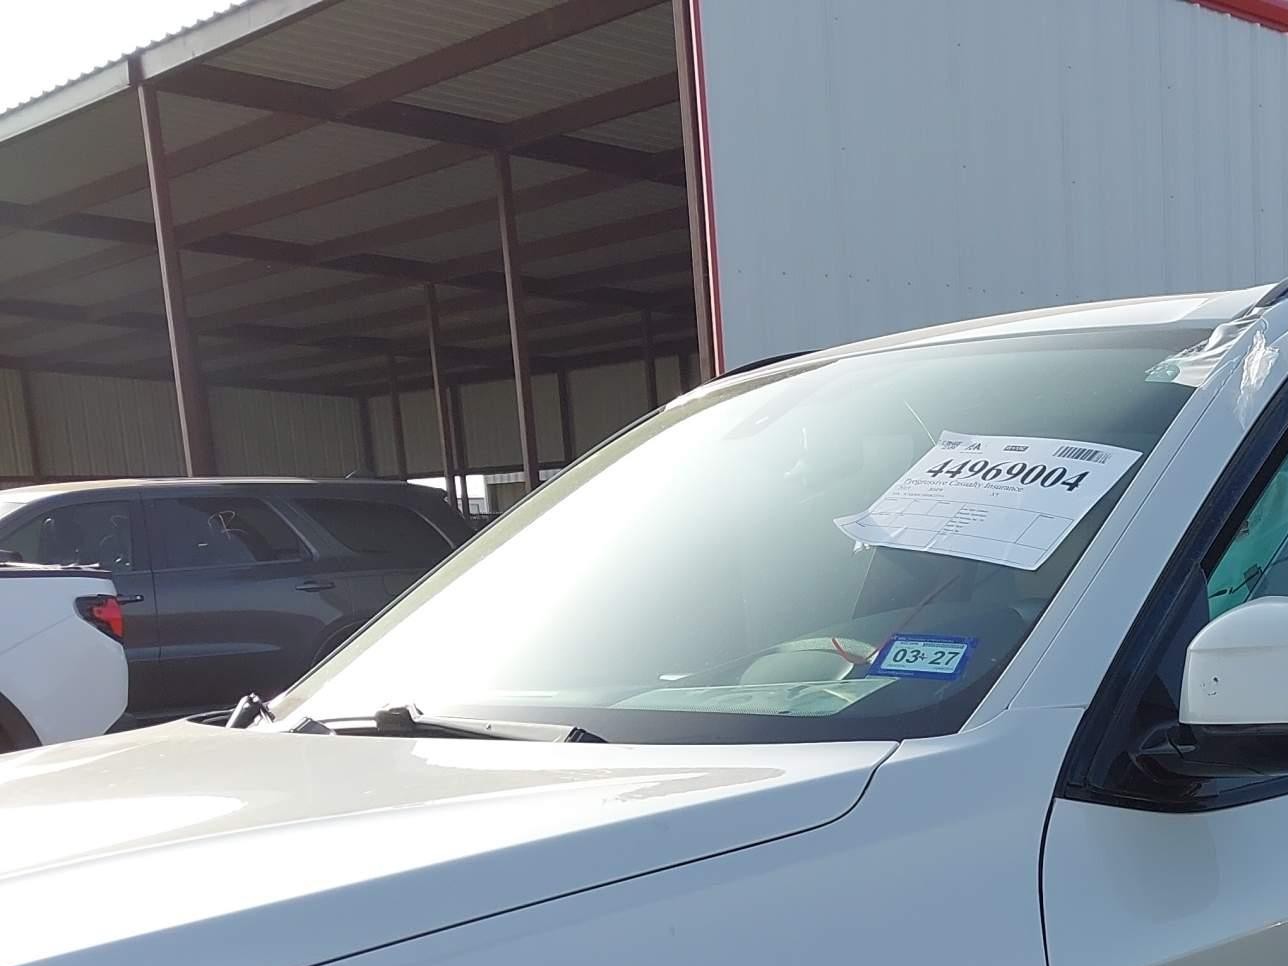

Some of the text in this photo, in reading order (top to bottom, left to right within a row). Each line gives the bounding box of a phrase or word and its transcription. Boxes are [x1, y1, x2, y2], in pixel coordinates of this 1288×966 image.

[926, 458, 1091, 492] 44969004
[892, 648, 962, 666] 03 27
